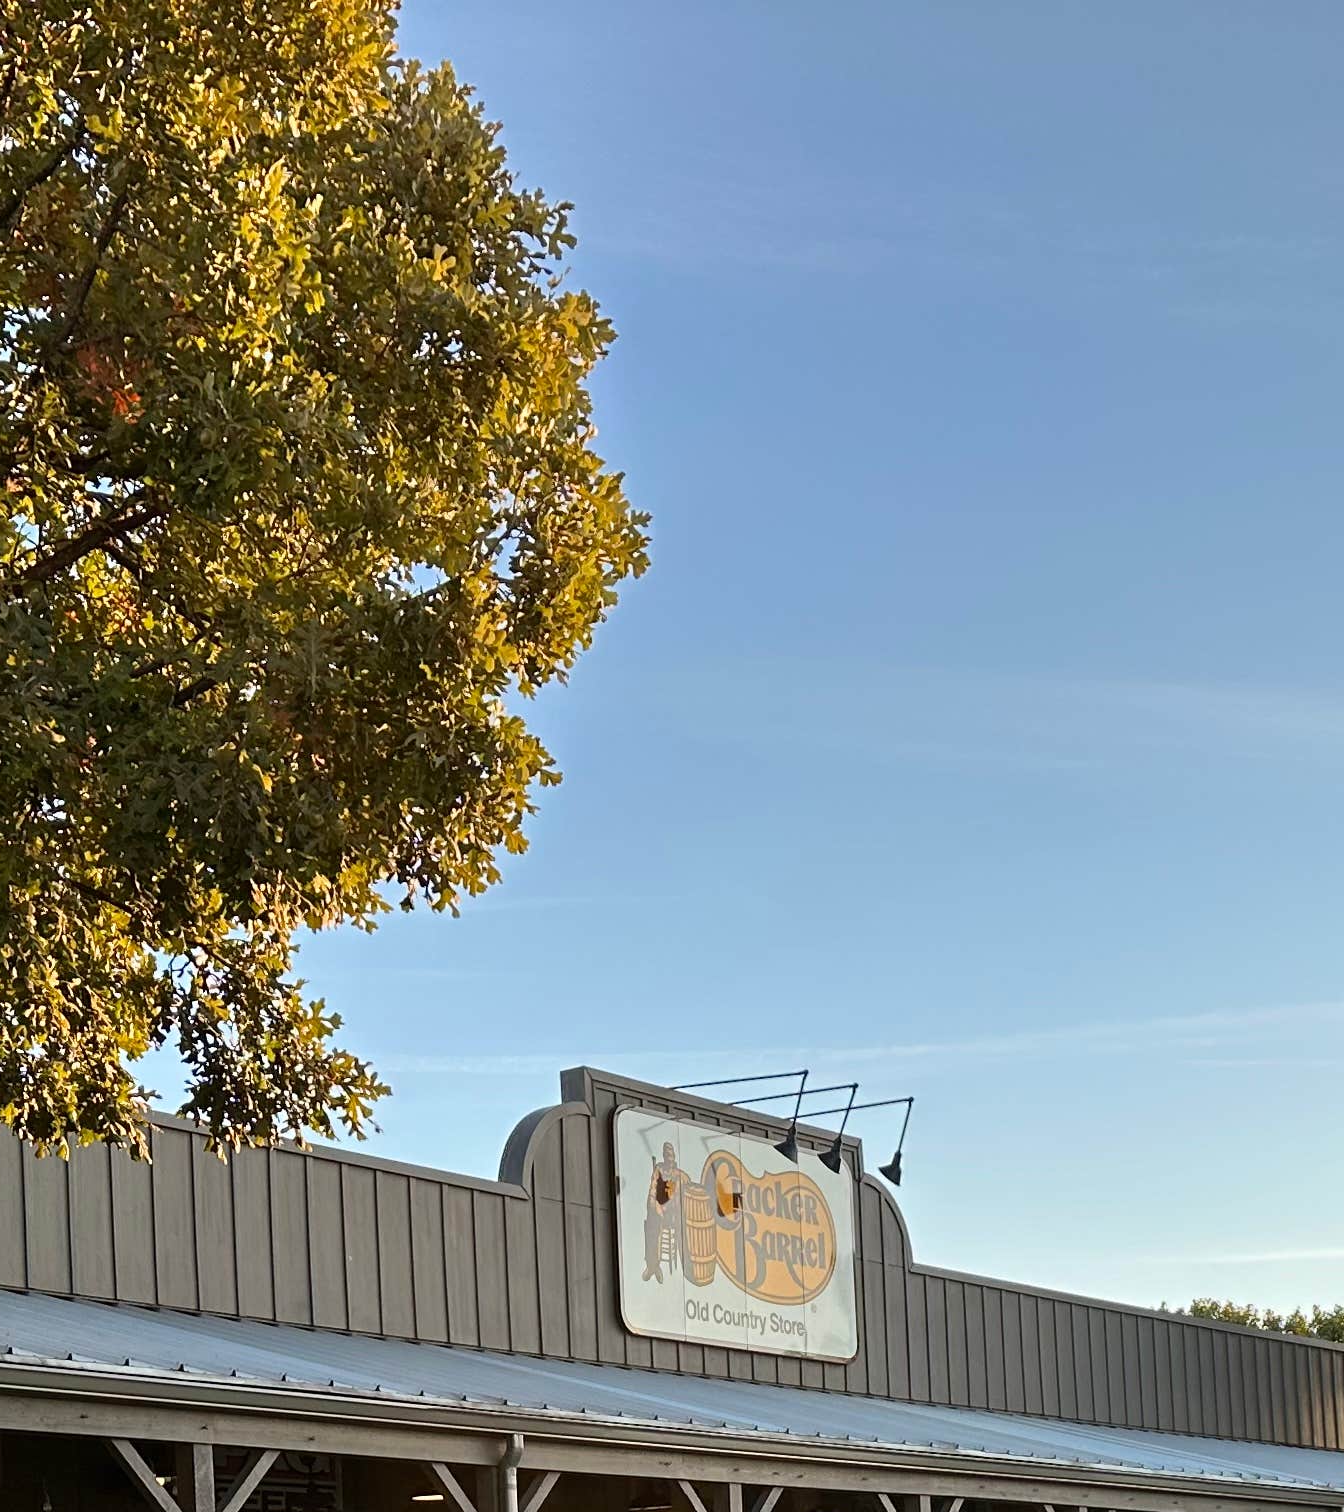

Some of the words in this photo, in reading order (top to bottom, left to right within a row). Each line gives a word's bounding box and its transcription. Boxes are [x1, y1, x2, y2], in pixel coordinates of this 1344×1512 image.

[685, 1299, 709, 1321] Old
[713, 1303, 766, 1335] Country
[770, 1312, 805, 1336] Store
